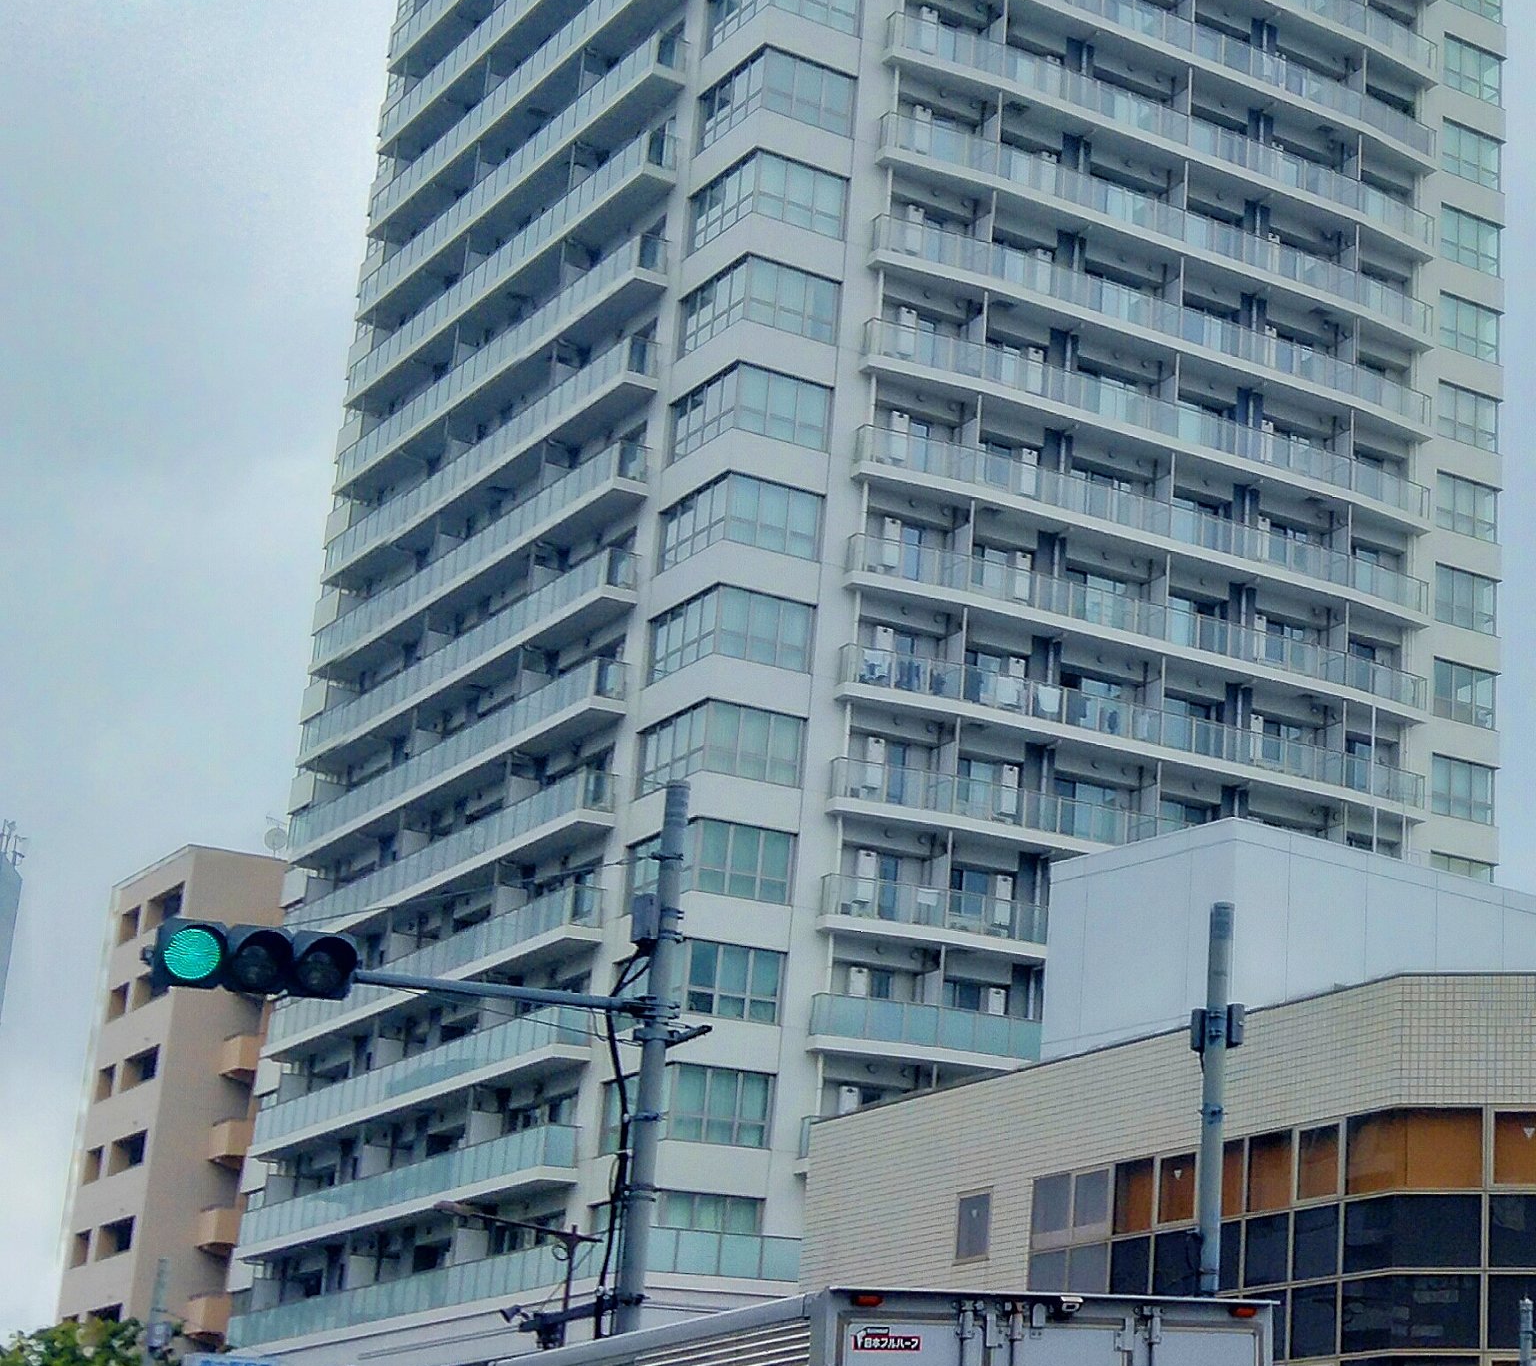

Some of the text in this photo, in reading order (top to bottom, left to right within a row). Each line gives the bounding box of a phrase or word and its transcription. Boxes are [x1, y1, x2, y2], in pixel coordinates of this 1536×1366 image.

[863, 1337, 919, 1349] 日本フルハーフ
